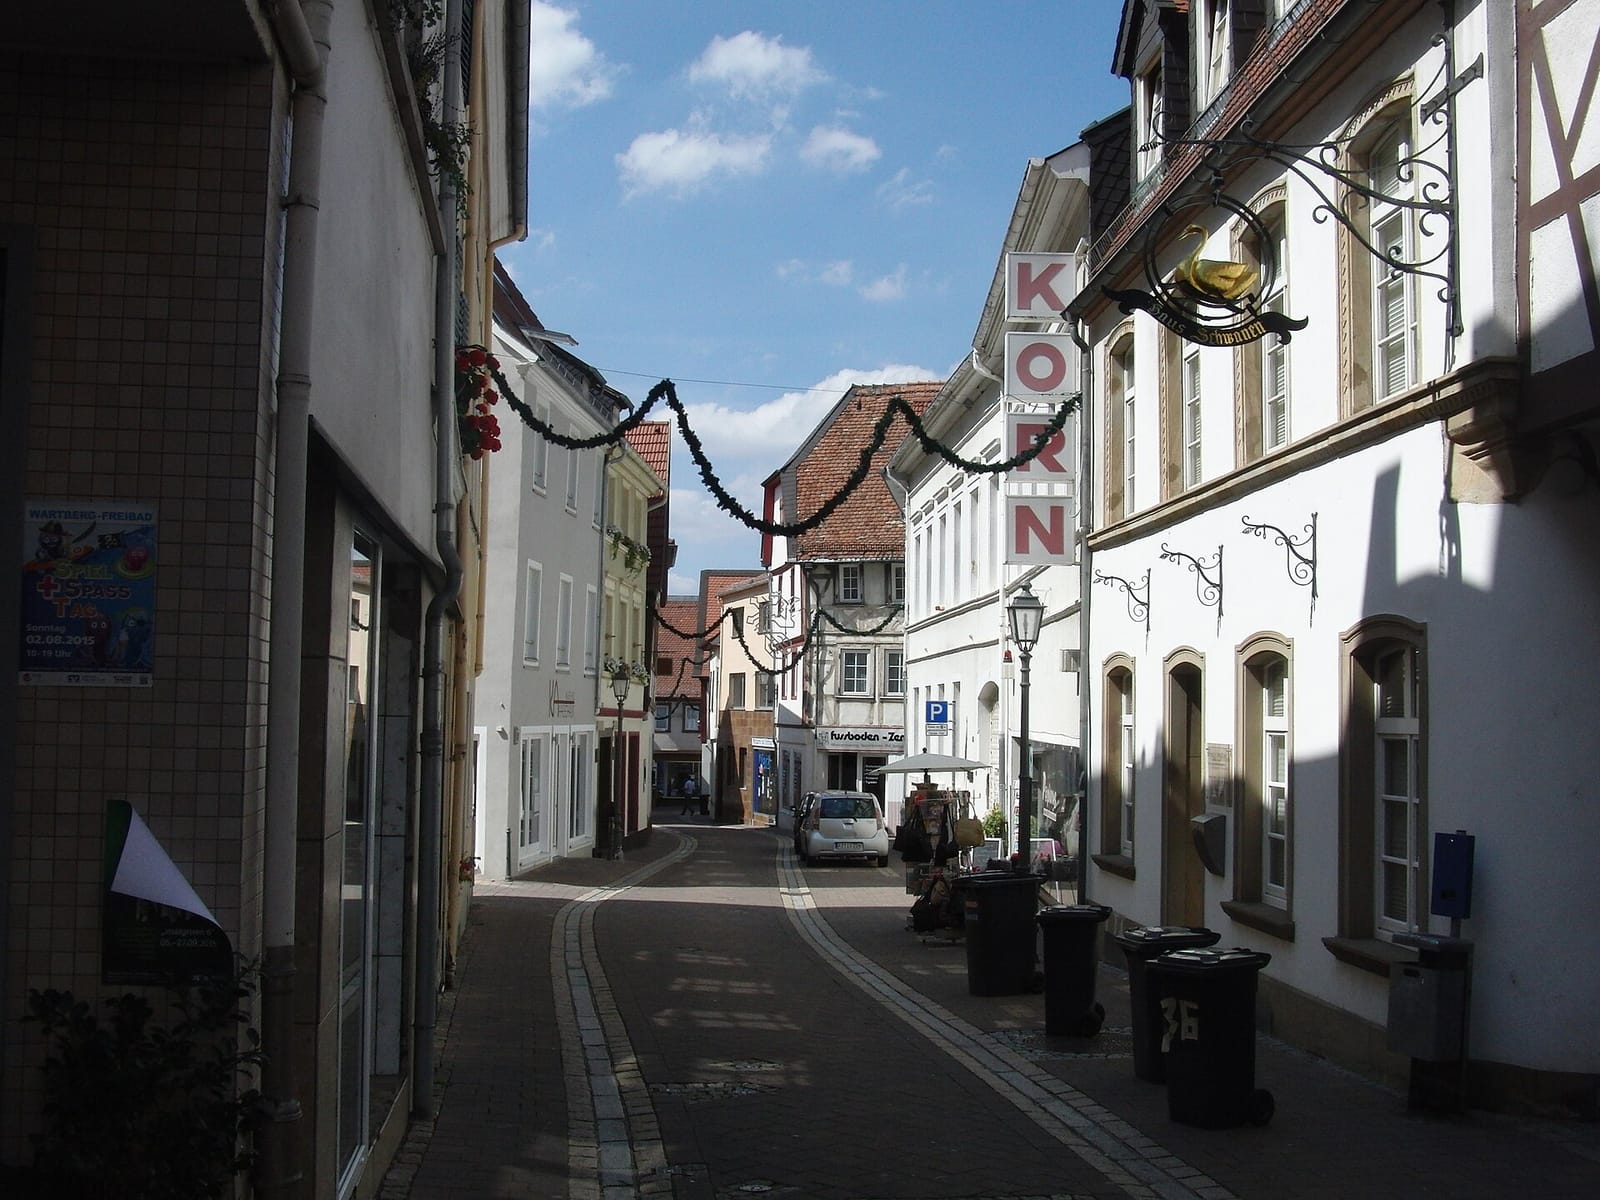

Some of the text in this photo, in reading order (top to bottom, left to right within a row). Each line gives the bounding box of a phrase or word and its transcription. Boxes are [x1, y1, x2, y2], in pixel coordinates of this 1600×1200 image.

[1189, 320, 1267, 345] Schwanen
[1015, 262, 1067, 555] KORN
[25, 624, 65, 634] Sonntag
[26, 635, 96, 645] 02.08.2015
[932, 704, 943, 720] P
[830, 731, 880, 741] fussboden
